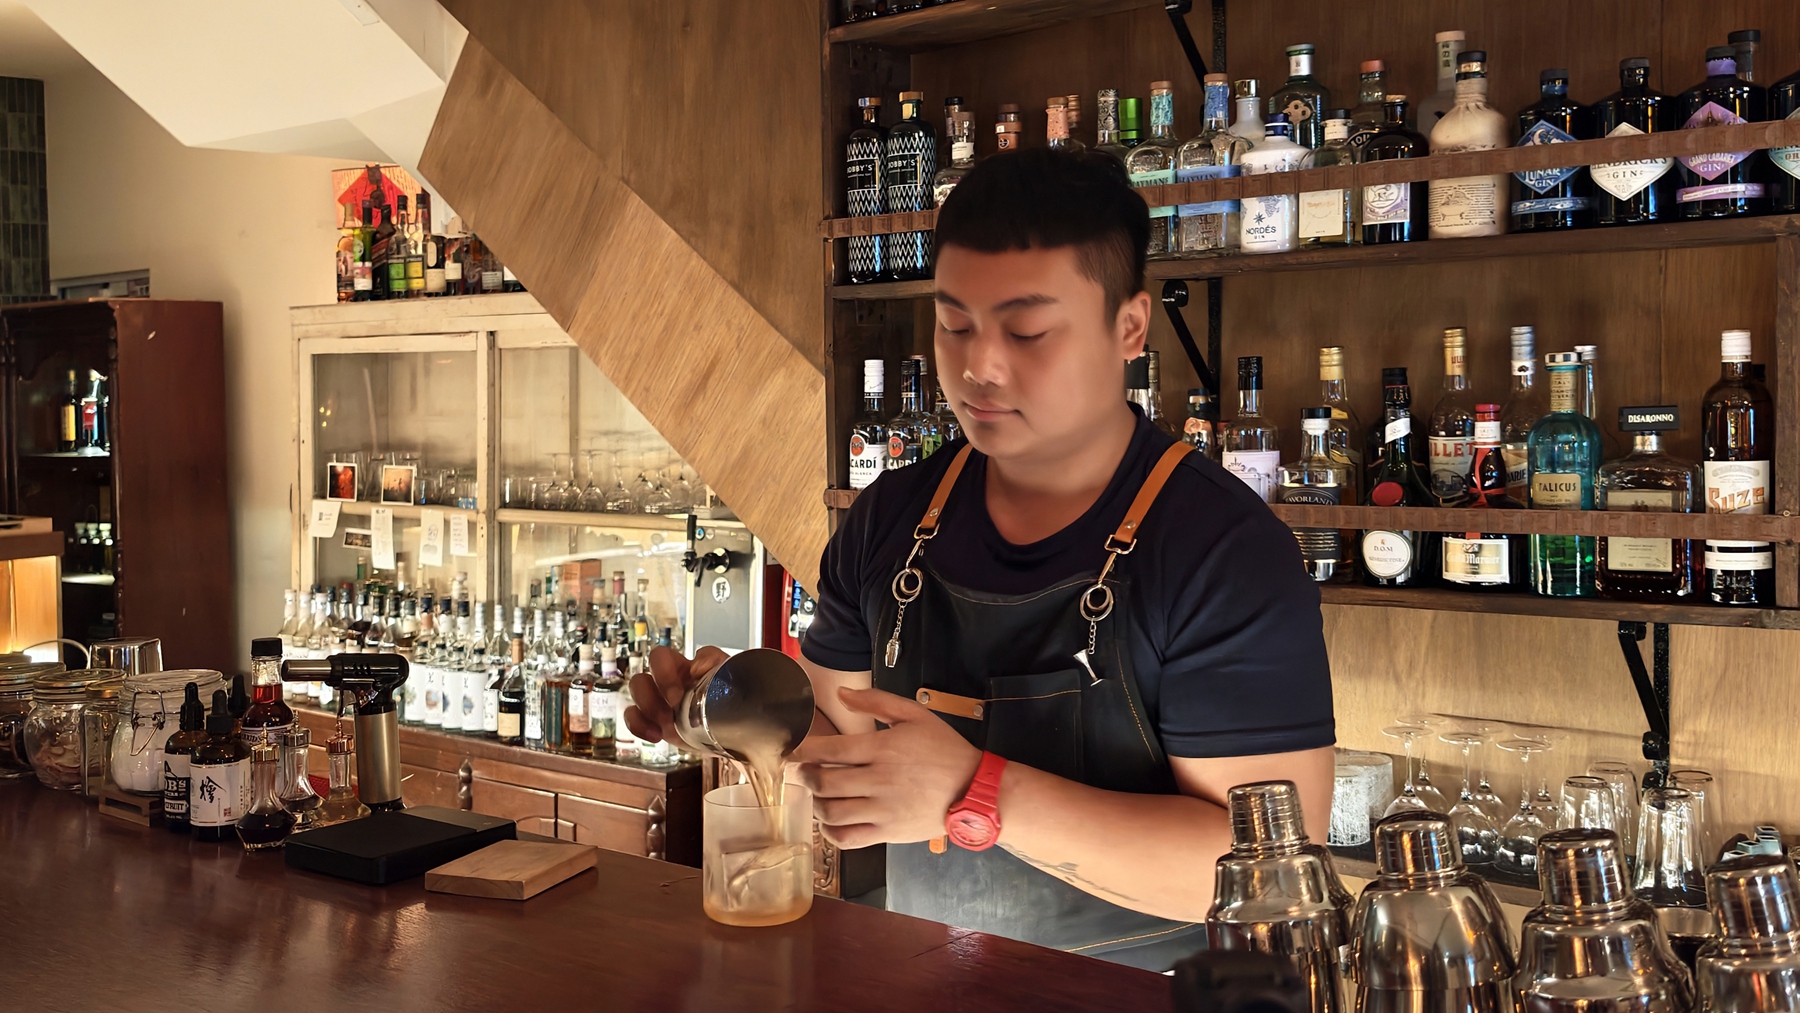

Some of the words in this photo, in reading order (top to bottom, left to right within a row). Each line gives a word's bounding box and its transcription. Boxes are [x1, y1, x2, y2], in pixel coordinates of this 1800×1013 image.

[1700, 163, 1721, 172] GIN
[1525, 167, 1561, 183] LUNAR
[1612, 171, 1637, 179] GIN
[1535, 178, 1555, 188] GIN
[1246, 225, 1277, 235] NORDÉS
[1627, 414, 1674, 423] DISARONNO
[1708, 487, 1765, 514] Suze
